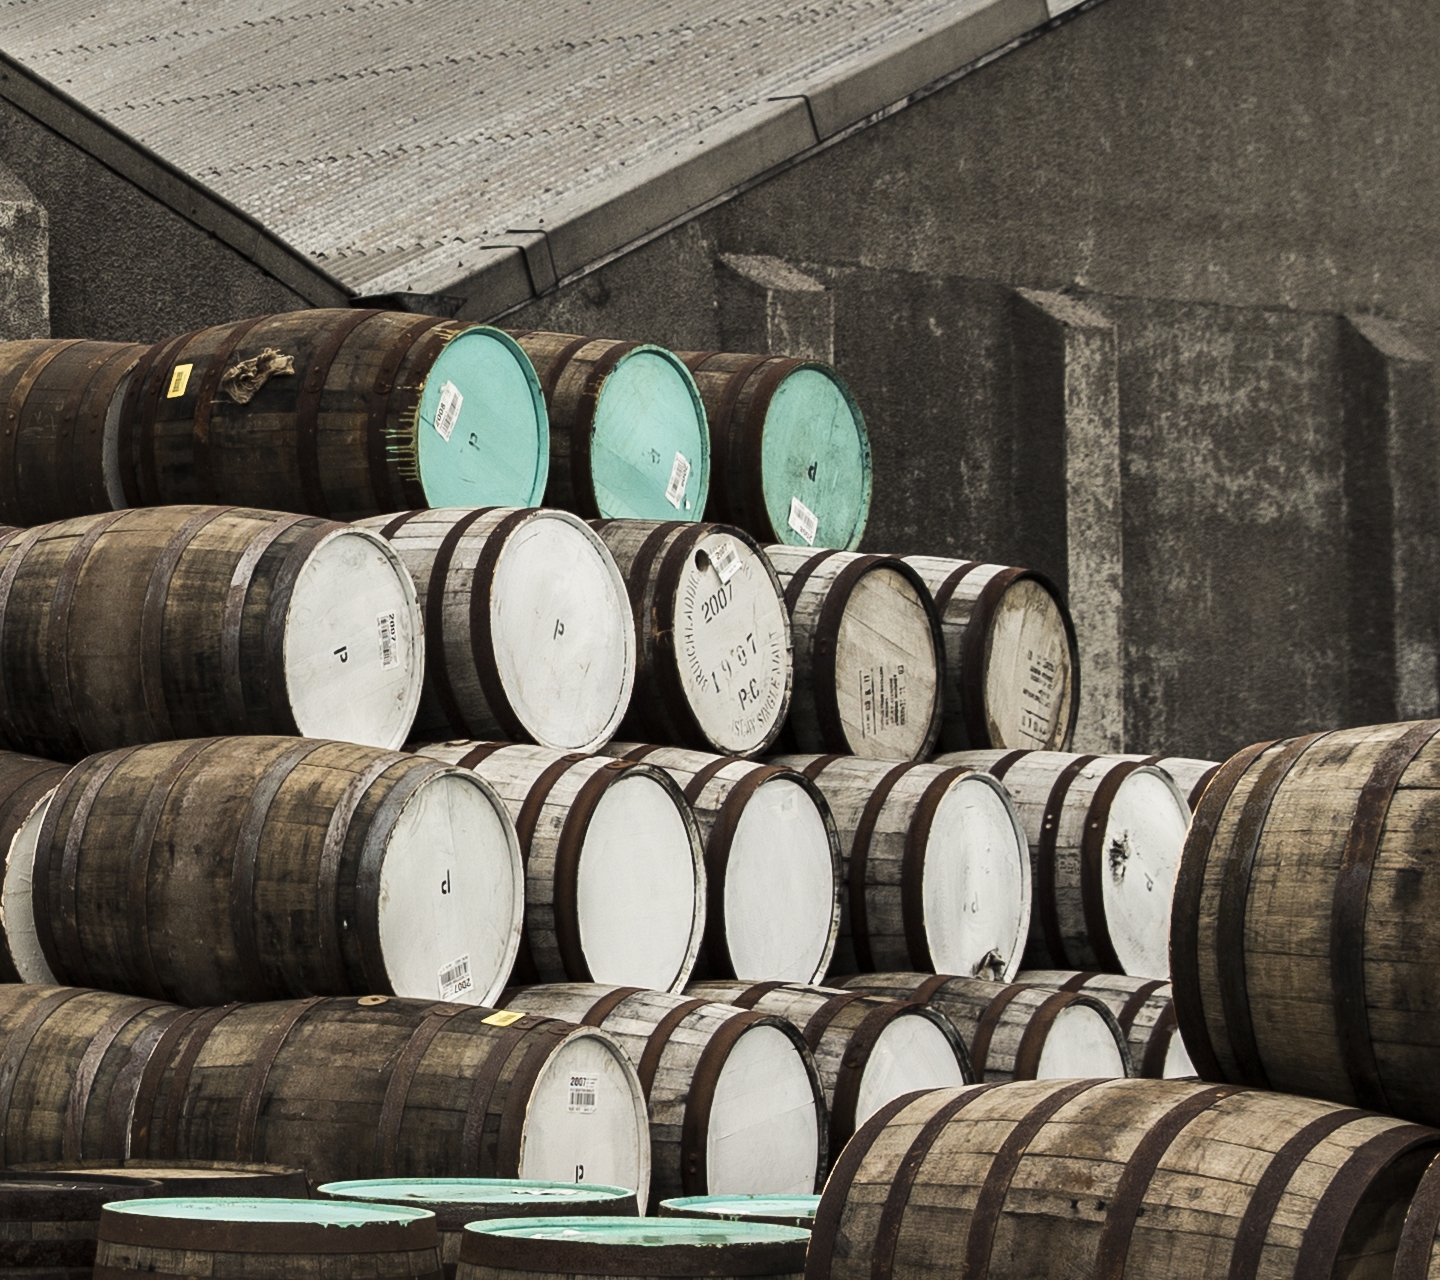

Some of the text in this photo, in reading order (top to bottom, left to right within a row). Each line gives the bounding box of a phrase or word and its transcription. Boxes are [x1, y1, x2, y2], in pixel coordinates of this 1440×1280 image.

[701, 579, 734, 624] 2007
[388, 613, 397, 642] 2007
[454, 977, 472, 994] 2007
[570, 1076, 587, 1087] 2007
